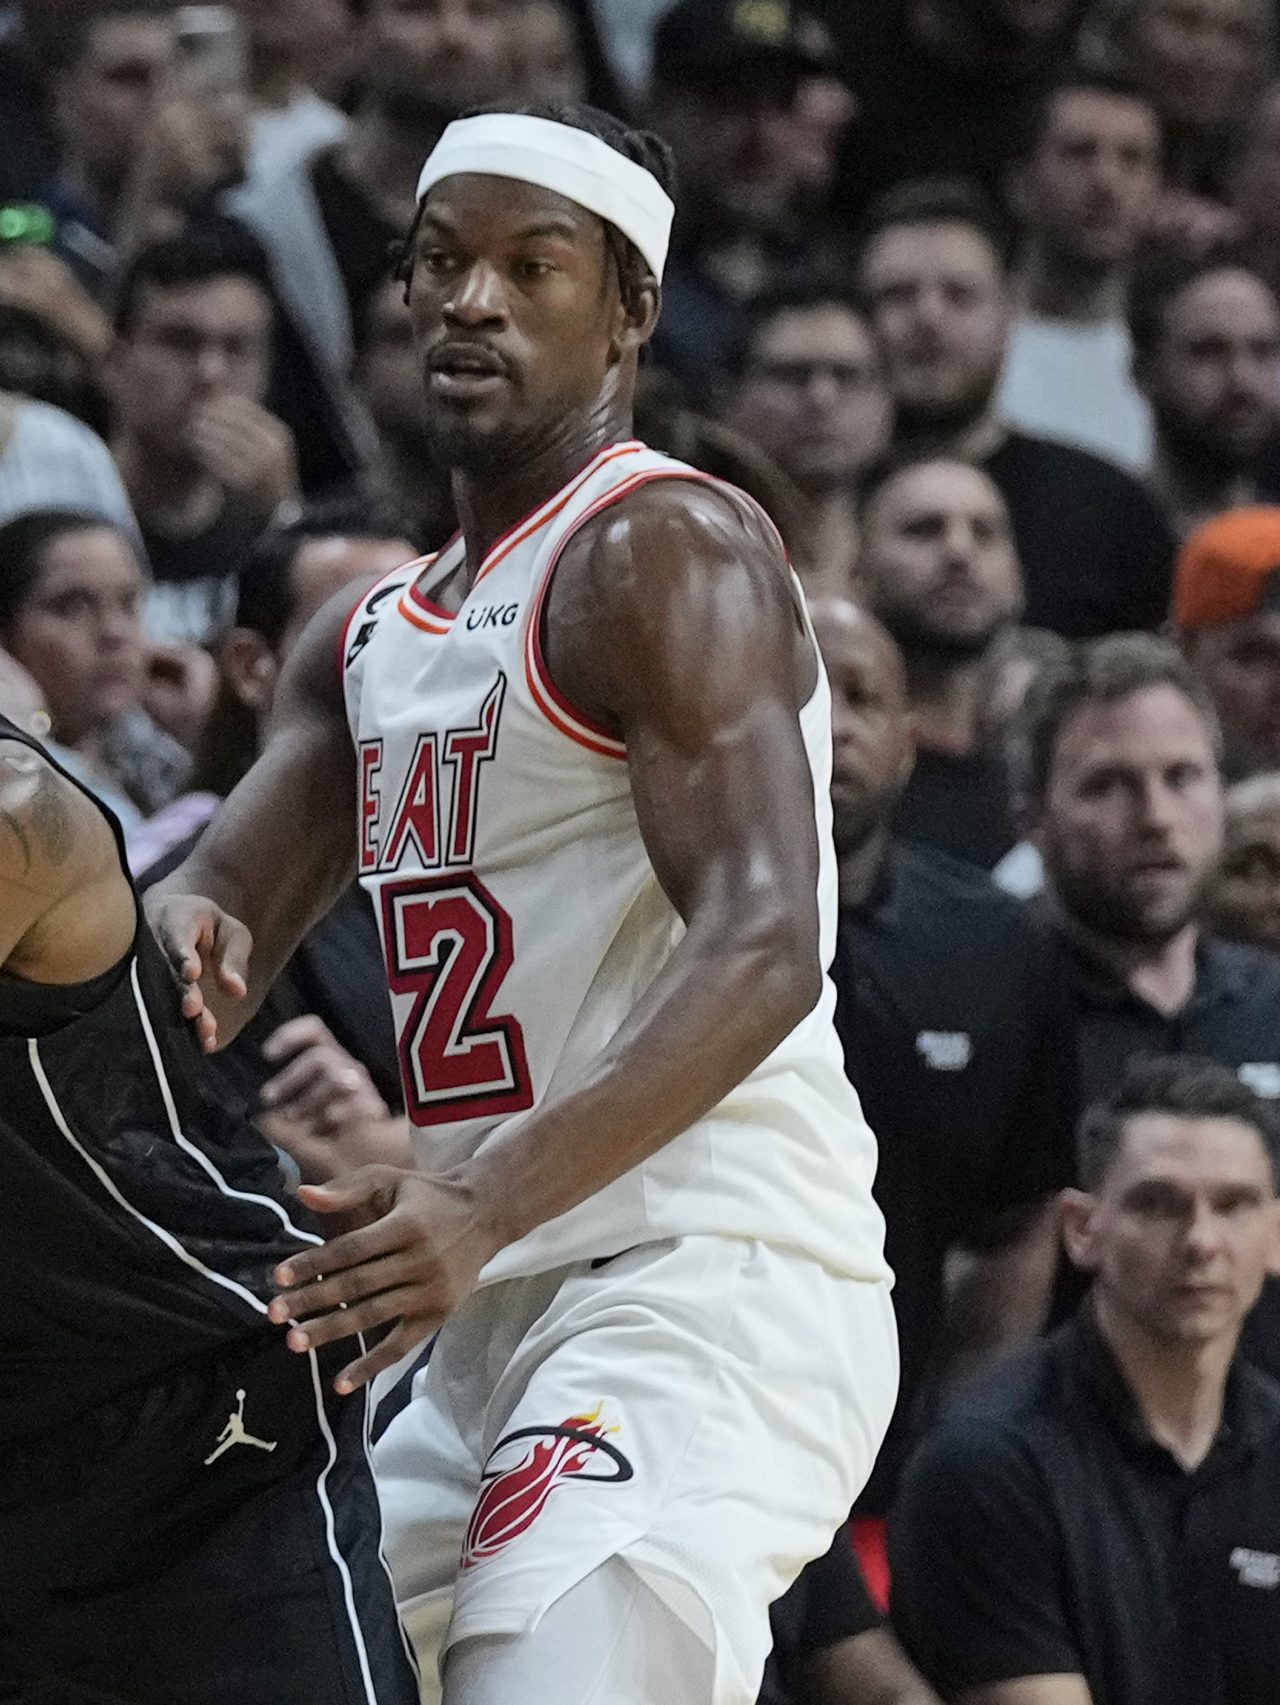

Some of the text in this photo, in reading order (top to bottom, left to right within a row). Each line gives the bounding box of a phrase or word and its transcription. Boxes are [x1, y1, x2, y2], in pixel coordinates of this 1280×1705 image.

[466, 603, 519, 631] UKG
[358, 670, 507, 877] EAT
[380, 870, 535, 1127] 2
